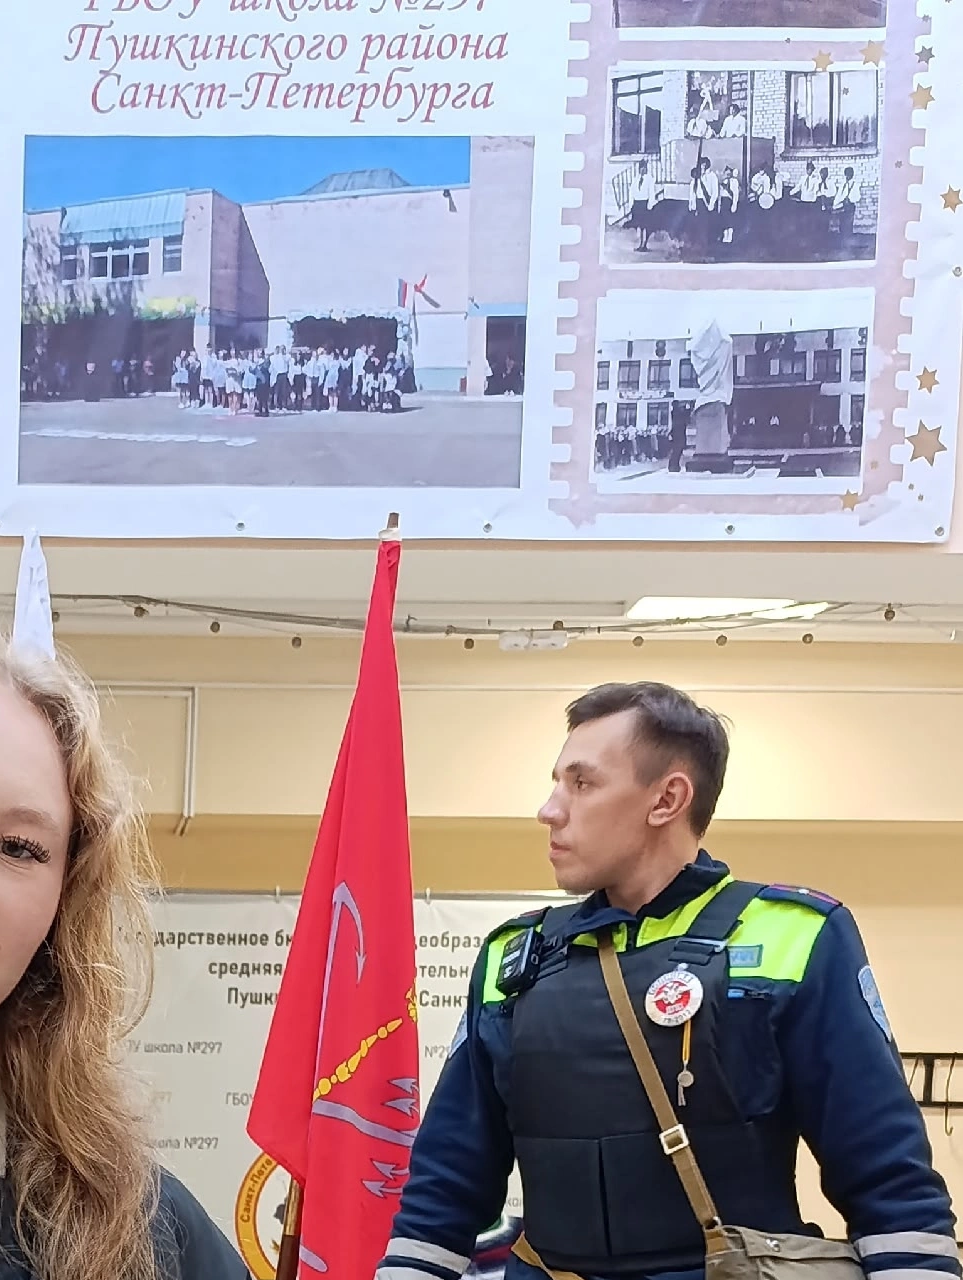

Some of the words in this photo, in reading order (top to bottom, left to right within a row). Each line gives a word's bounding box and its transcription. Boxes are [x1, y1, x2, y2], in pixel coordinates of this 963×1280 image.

[64, 20, 348, 77] Пушкинского
[360, 23, 510, 74] района
[90, 66, 495, 123] Санкт-Петербурга
[116, 928, 269, 949] дарственное
[415, 931, 481, 953] еобраз
[208, 962, 283, 978] средняя
[143, 1041, 184, 1054] школа
[187, 1041, 223, 1054] №297
[153, 1137, 181, 1150] ола
[183, 1136, 219, 1150] №297
